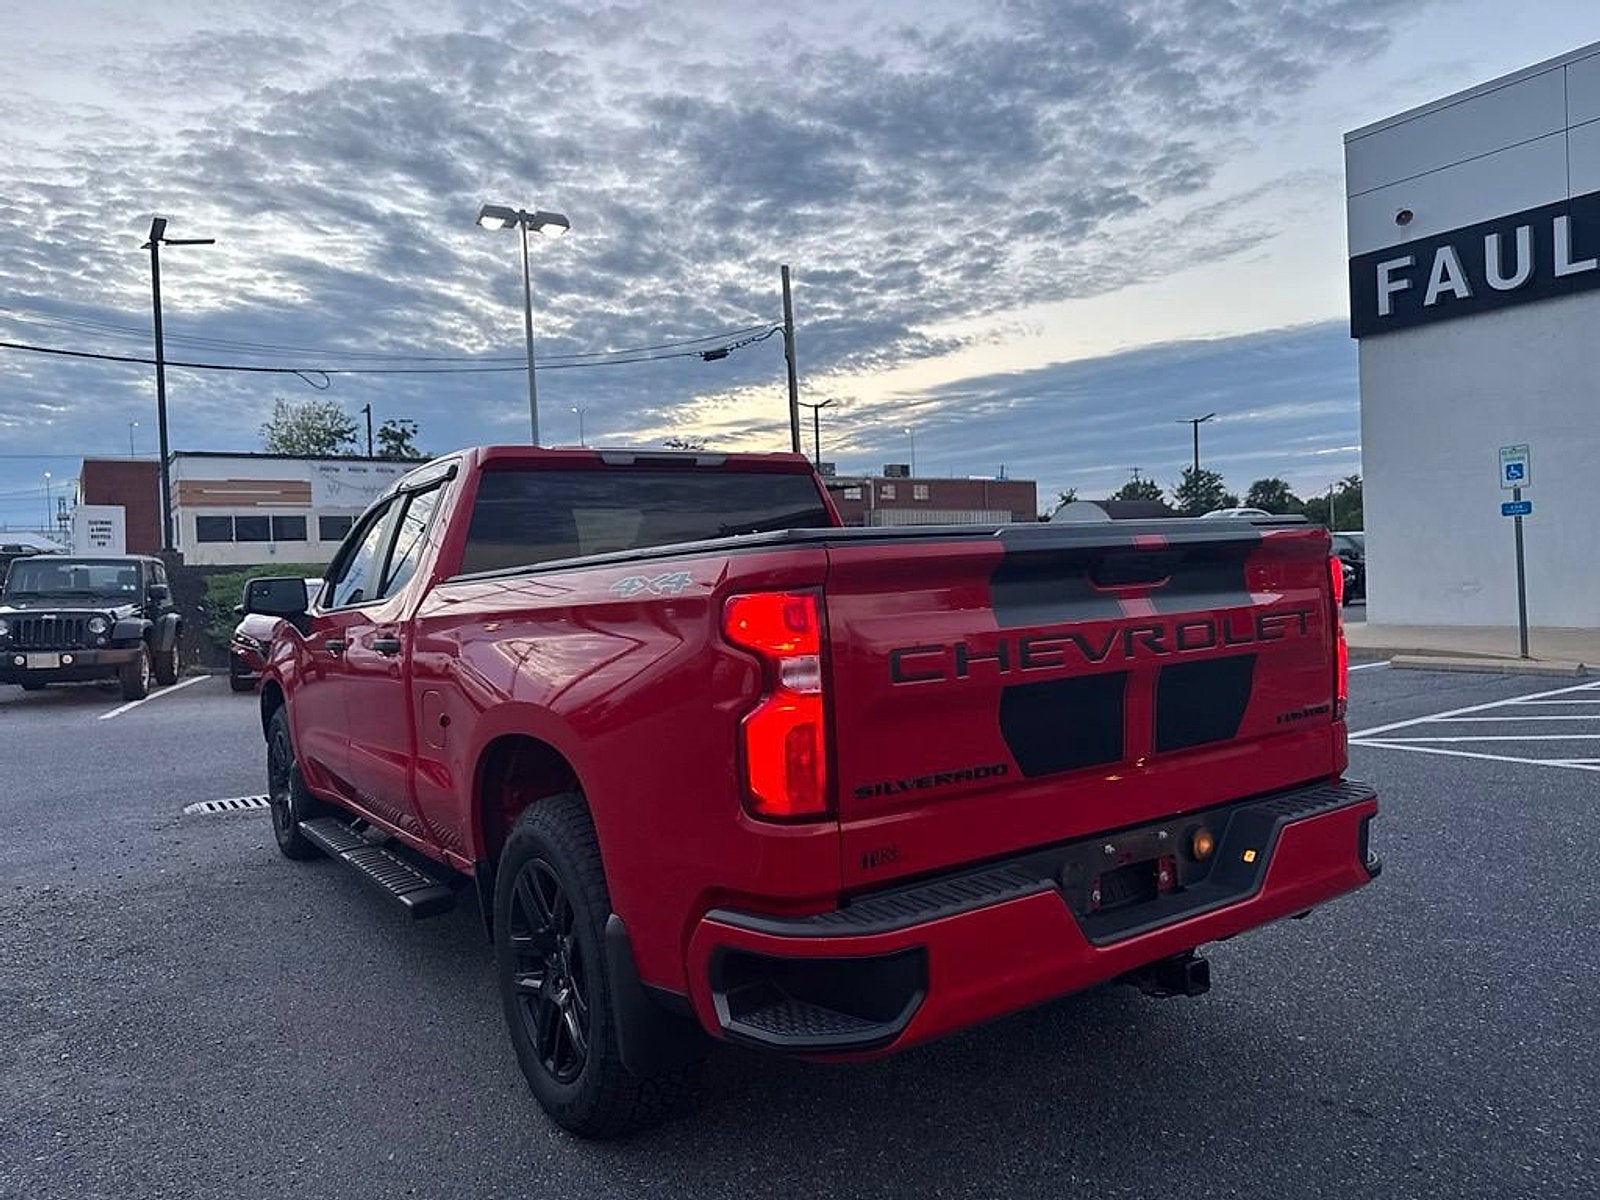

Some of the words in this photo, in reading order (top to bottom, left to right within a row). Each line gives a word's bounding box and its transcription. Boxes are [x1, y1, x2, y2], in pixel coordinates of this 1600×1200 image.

[1376, 215, 1599, 317] FAUL
[890, 609, 1317, 686] CHEVROLET
[853, 763, 1008, 799] SILVERADO
